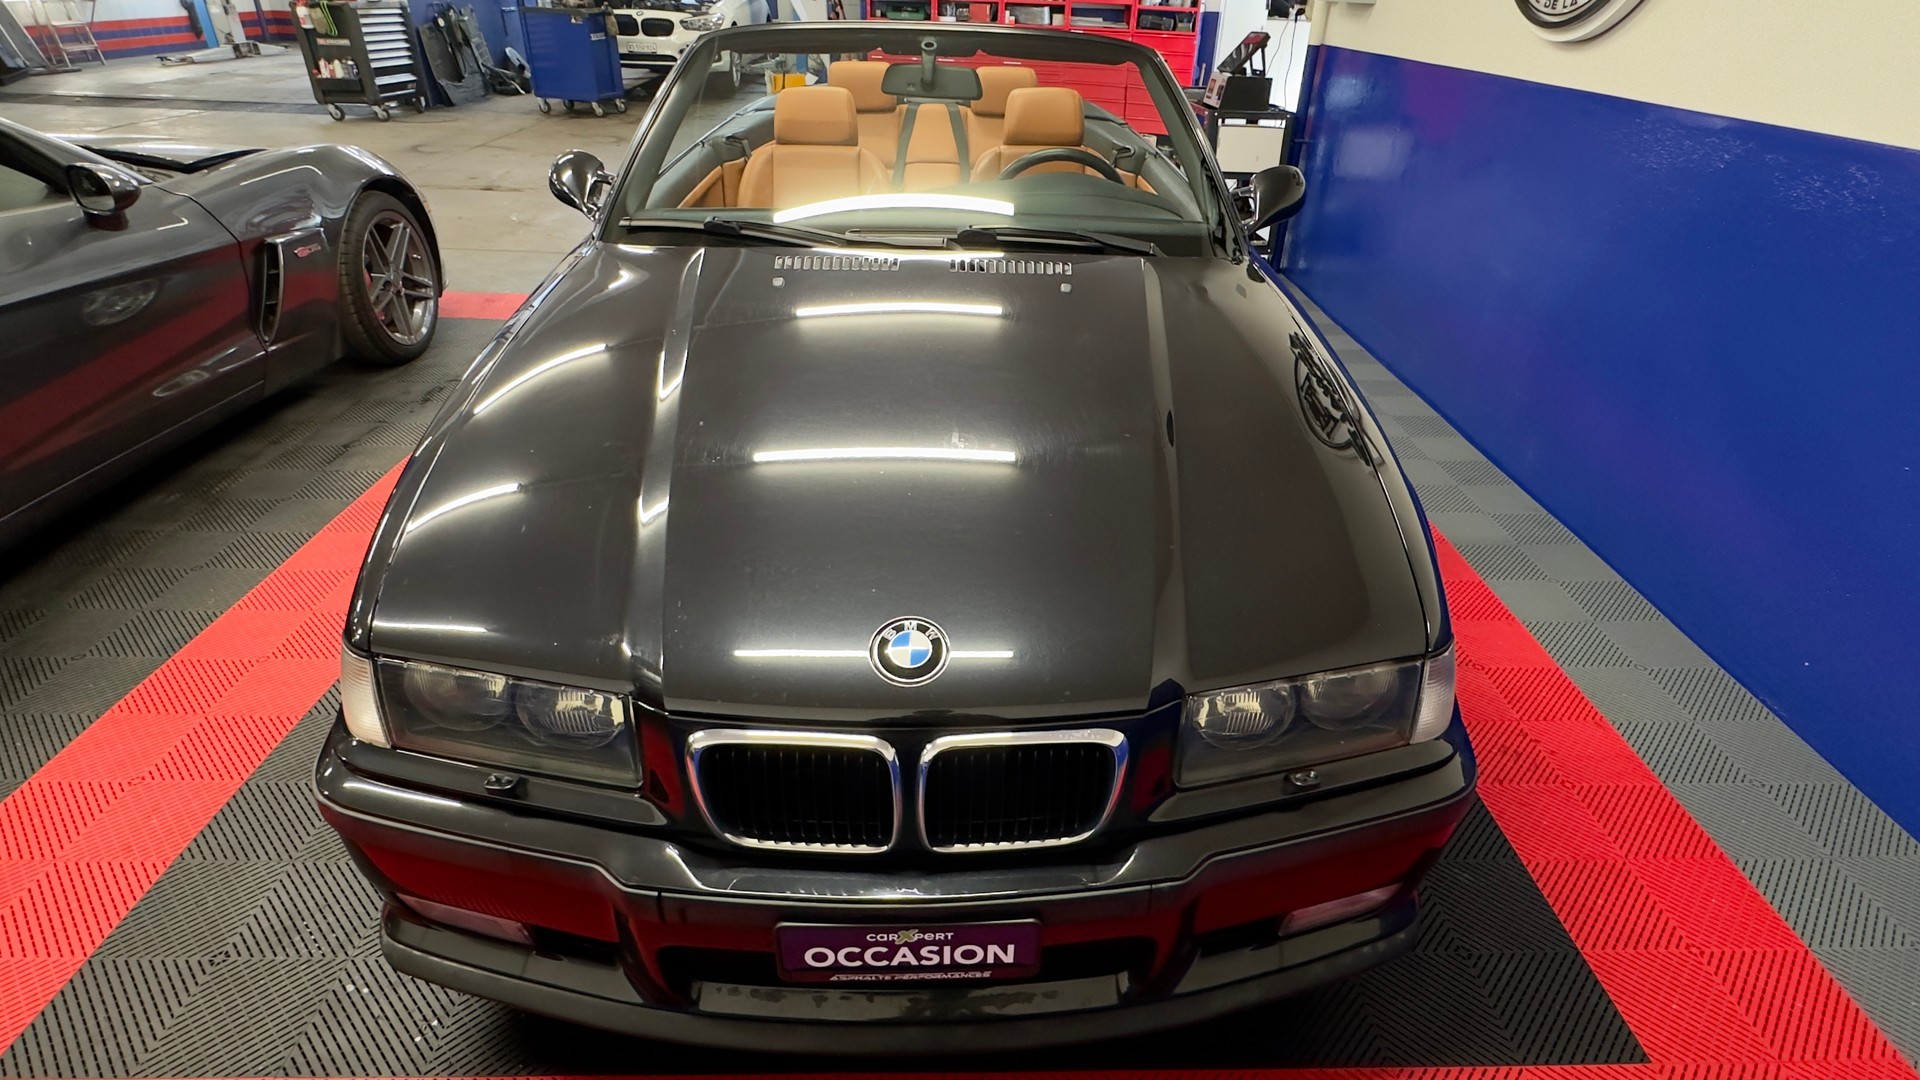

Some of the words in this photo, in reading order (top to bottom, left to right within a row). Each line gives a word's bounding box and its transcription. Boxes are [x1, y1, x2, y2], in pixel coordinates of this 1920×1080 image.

[1543, 0, 1558, 9] DE
[882, 621, 940, 641] BMW
[804, 944, 1015, 967] OCCASION
[829, 973, 892, 982] ASPHALTE
[894, 970, 992, 981] PERFORMANCES
